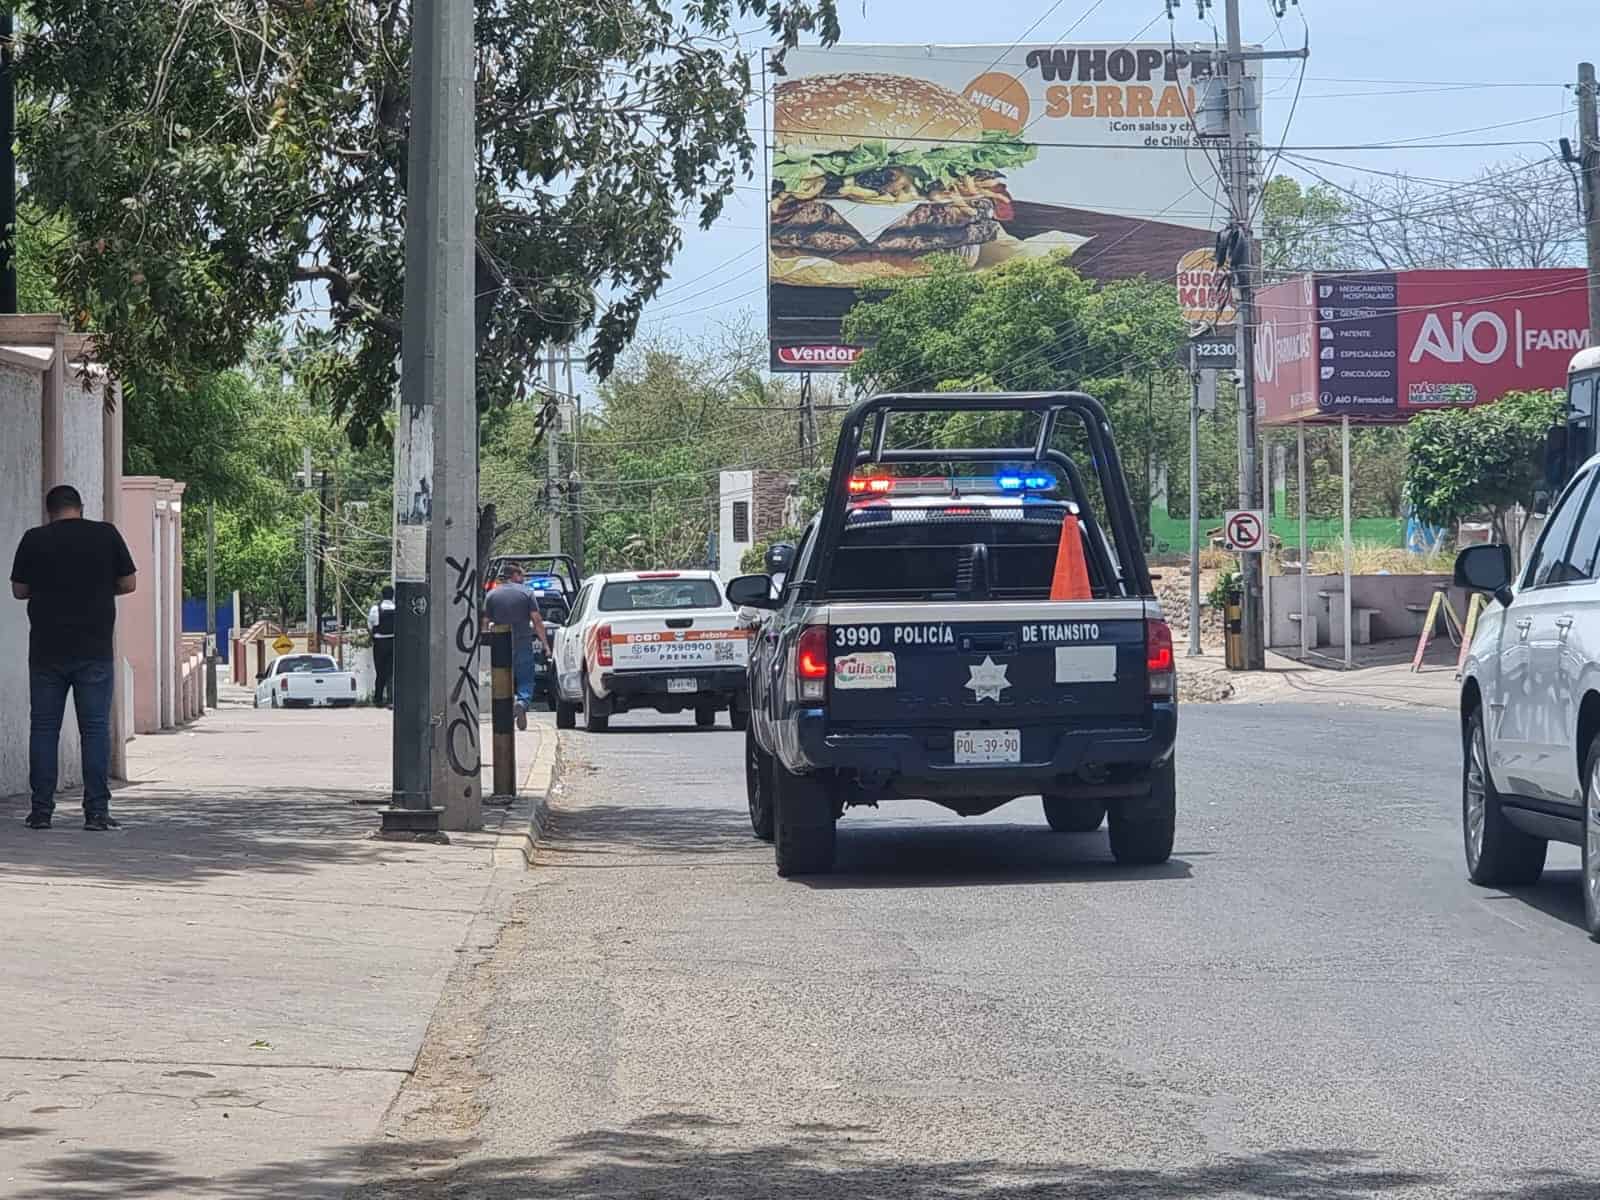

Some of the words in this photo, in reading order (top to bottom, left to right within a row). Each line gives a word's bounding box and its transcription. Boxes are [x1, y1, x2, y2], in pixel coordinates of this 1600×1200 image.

[1138, 121, 1168, 132] salsa
[1169, 123, 1178, 134] y
[1144, 135, 1159, 146] de
[1161, 135, 1190, 147] Chile
[791, 346, 856, 361] Vendor
[1340, 350, 1396, 358] ESPECIALIZADO
[1352, 395, 1394, 404] Farmacias
[835, 627, 881, 646] 3990
[894, 622, 954, 643] POLICÍA
[1022, 625, 1038, 642] DE
[1040, 623, 1100, 641] TRANSITO
[956, 739, 1018, 753] POL-39-90
